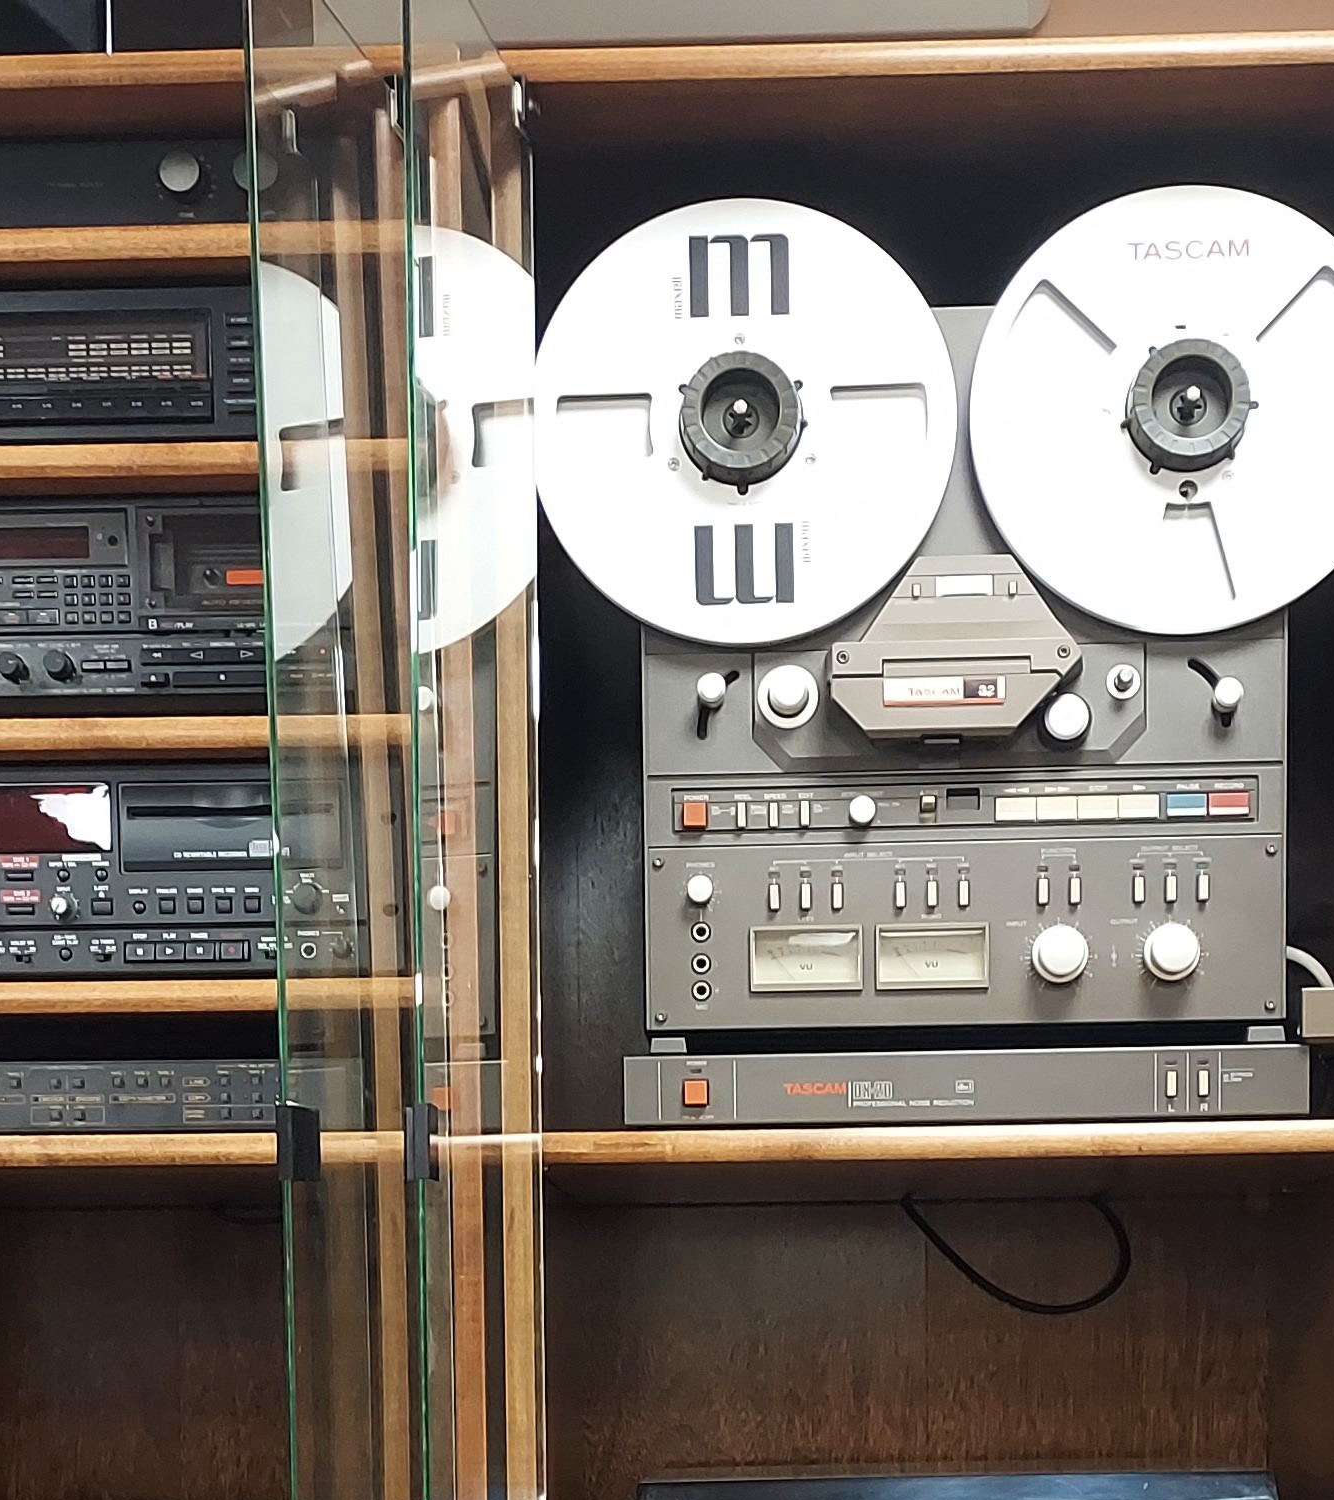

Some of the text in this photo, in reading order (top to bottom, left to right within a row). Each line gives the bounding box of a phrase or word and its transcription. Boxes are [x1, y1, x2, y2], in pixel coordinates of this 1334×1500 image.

[1127, 239, 1250, 261] TASCAM
[672, 277, 683, 320] maxell
[148, 618, 157, 630] B
[977, 684, 996, 698] 32
[799, 963, 813, 971] VU
[784, 1082, 847, 1095] TASCAM
